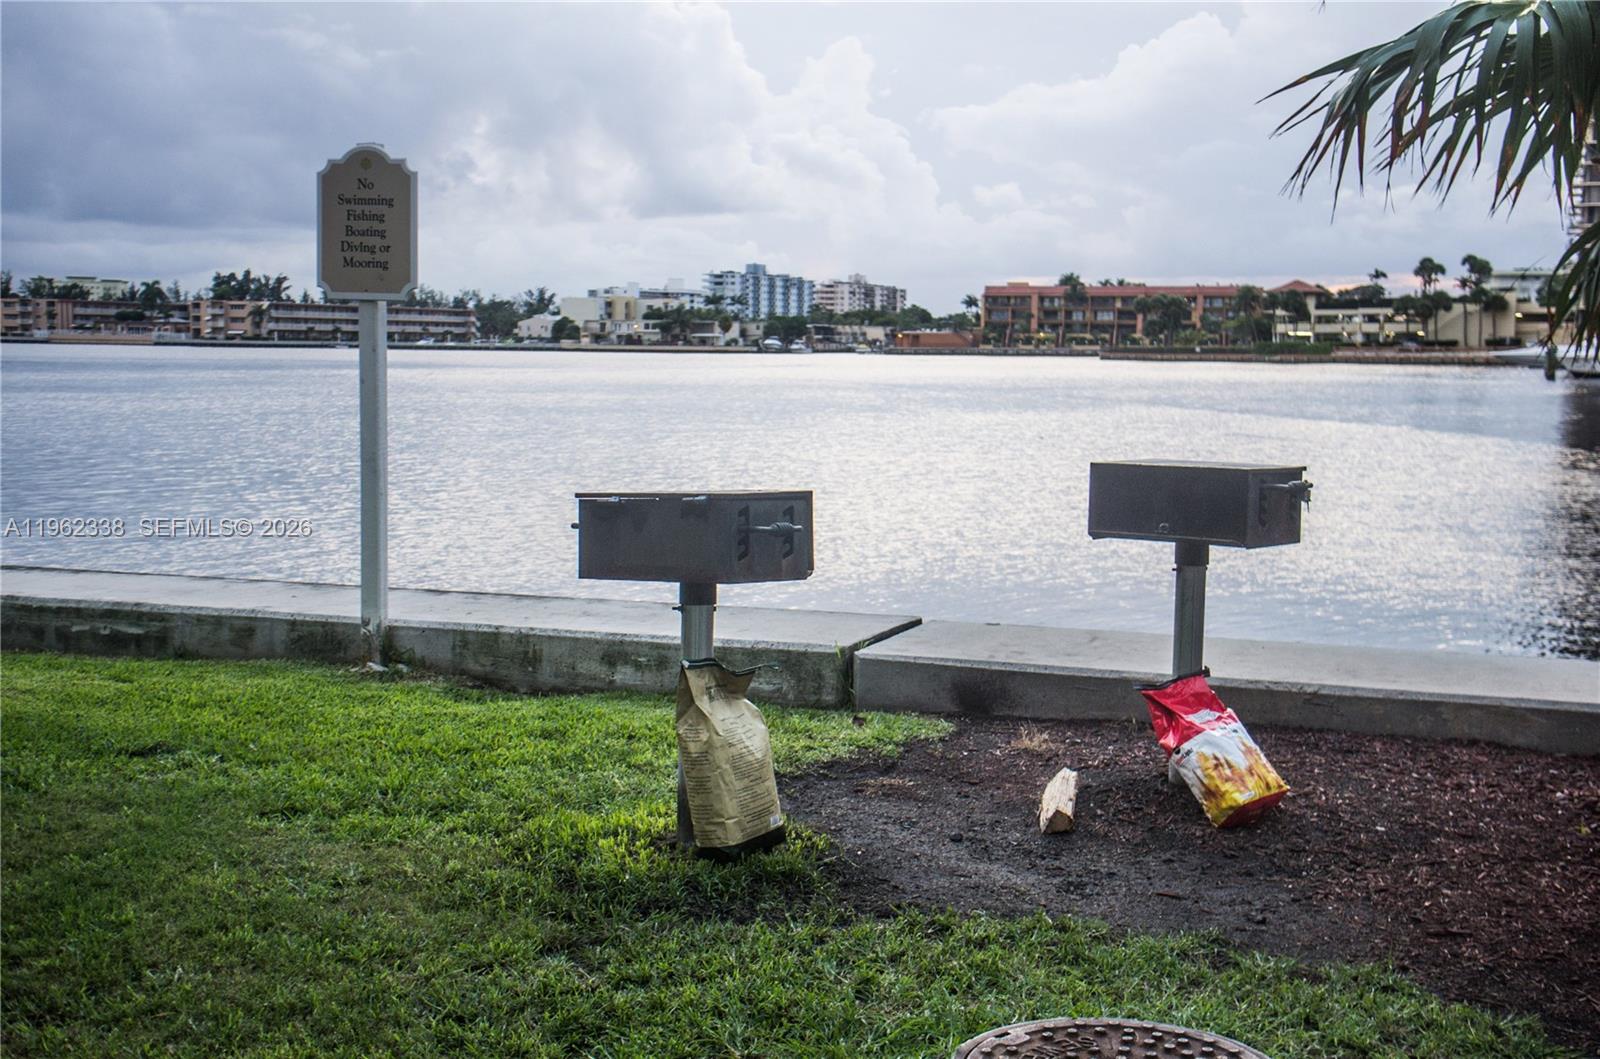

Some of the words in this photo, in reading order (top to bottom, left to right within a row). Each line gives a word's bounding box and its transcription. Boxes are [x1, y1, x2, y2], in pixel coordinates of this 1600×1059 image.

[357, 178, 374, 190] No
[337, 193, 394, 208] Swimming
[346, 209, 385, 224] Fishing
[345, 225, 386, 240] Boating
[340, 240, 376, 255] Diving
[379, 244, 392, 253] or
[342, 256, 389, 271] Mooring
